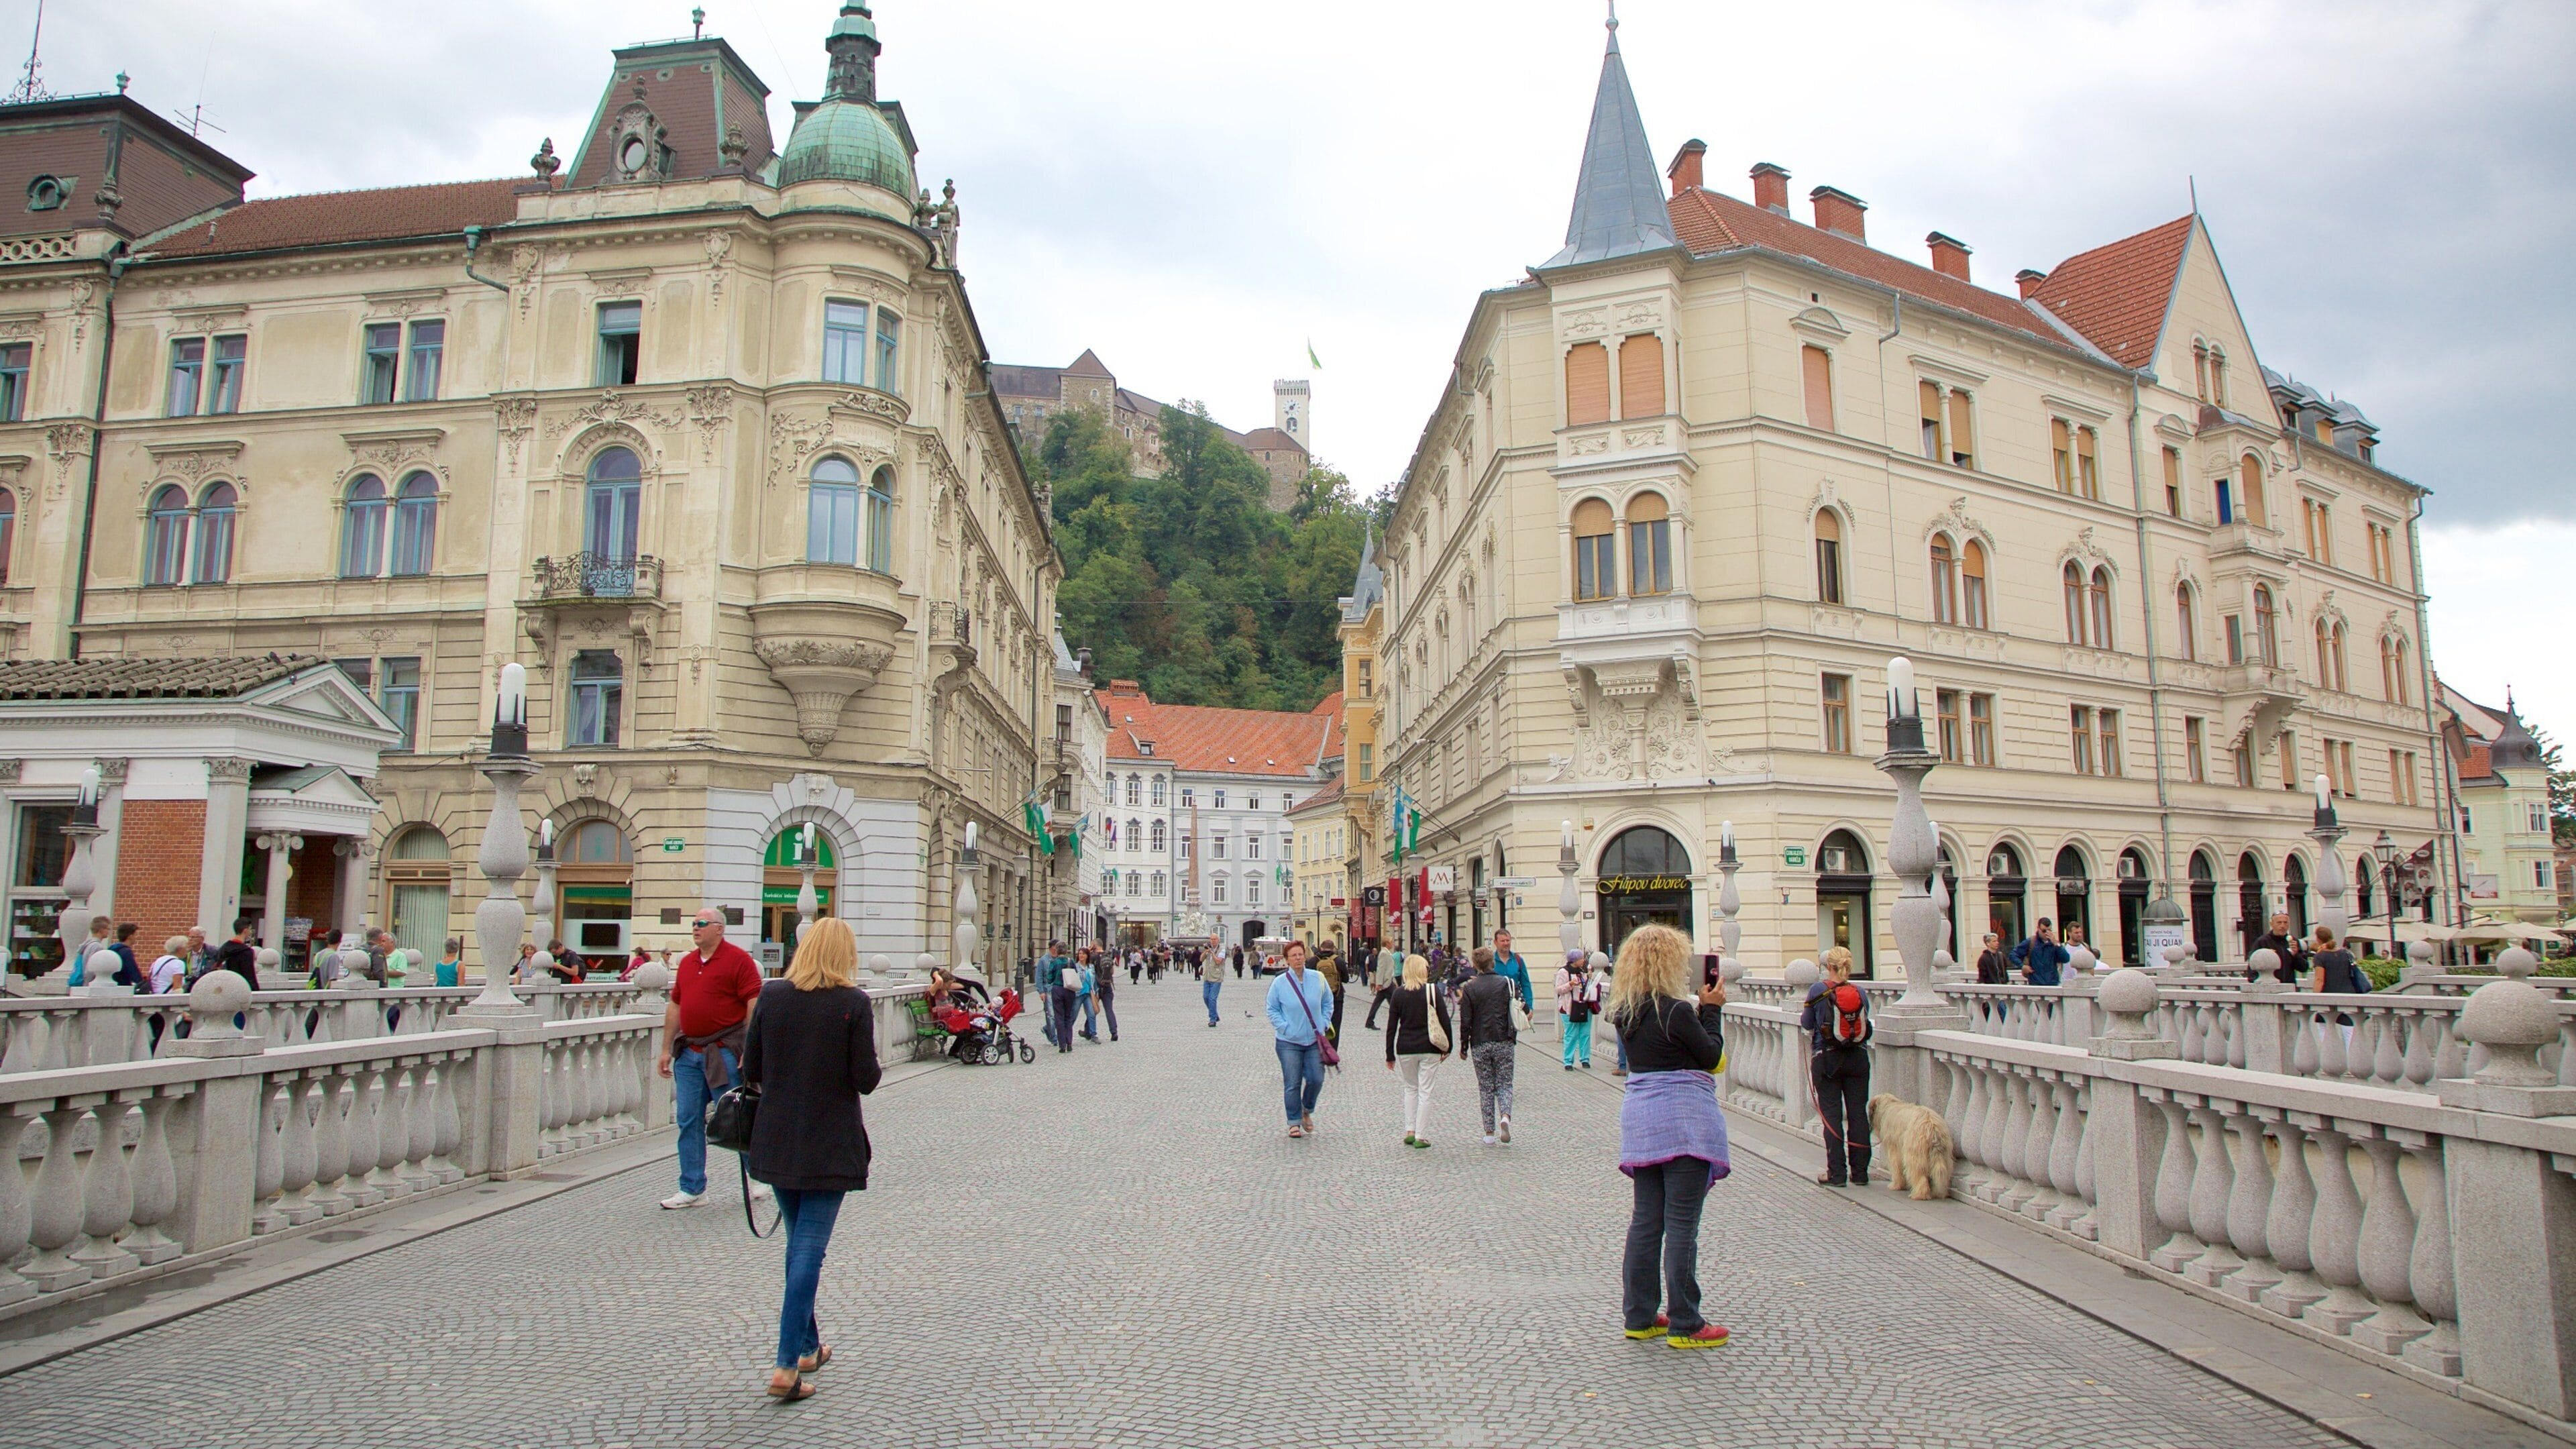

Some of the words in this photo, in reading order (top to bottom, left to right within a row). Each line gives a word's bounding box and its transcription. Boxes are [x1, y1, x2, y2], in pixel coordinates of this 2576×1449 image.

[1598, 873, 1648, 894] Filipov
[1650, 874, 1688, 890] dvorec
[2161, 938, 2182, 947] QUAN
